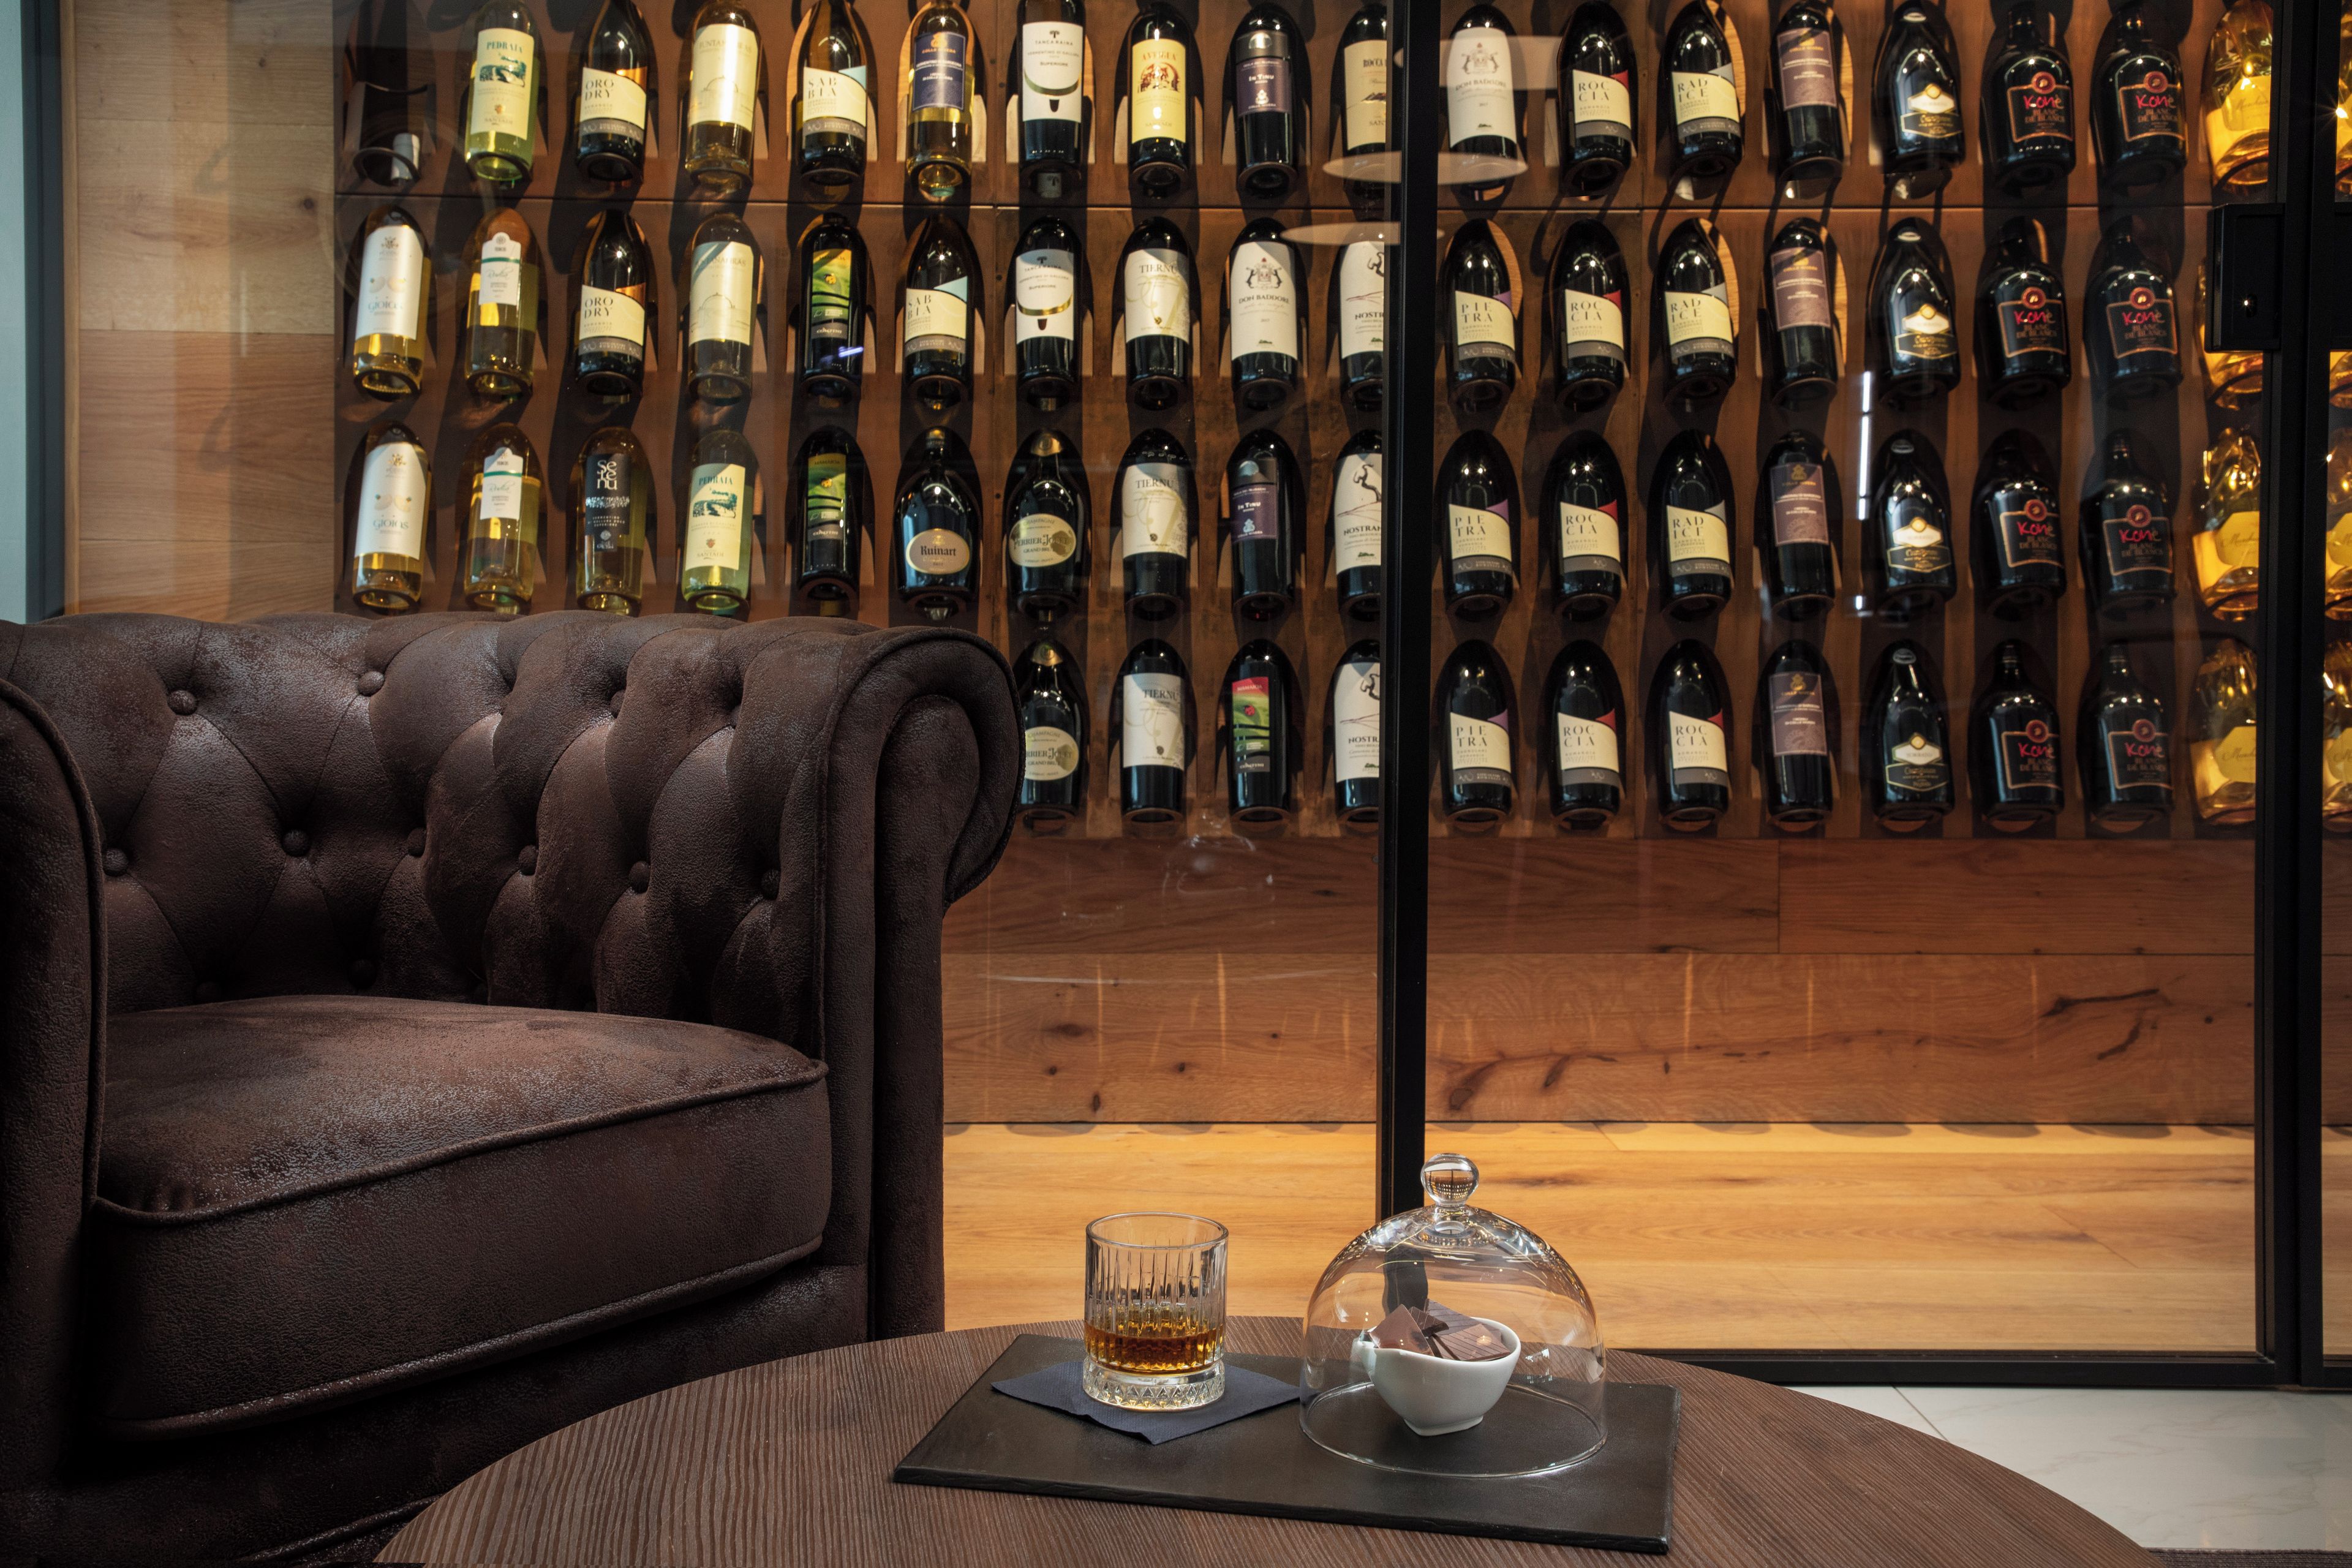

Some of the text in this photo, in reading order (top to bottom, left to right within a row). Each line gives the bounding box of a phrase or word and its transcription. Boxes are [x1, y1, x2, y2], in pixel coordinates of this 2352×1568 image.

[585, 79, 614, 90] ORO
[809, 76, 837, 88] SAB
[1578, 81, 1610, 92] ROC
[1678, 78, 1708, 92] RAD
[584, 89, 613, 101] DRY
[1578, 91, 1610, 102] CIA
[1678, 91, 1709, 103] ICE
[584, 296, 614, 309] ORO
[907, 294, 932, 308] SAB
[1238, 295, 1255, 305] DON
[1570, 300, 1602, 311] ROC
[1670, 298, 1702, 311] RAD
[584, 306, 612, 318] DRY
[1461, 301, 1492, 314] PIE
[1461, 313, 1493, 324] TRA
[1571, 311, 1602, 322] CIA
[1672, 309, 1702, 323] ICE
[698, 475, 733, 486] PEDRAIA
[1136, 479, 1175, 489] TIERNU
[1455, 514, 1485, 527] PIE
[1566, 513, 1597, 525] ROC
[1673, 516, 1704, 529] RAD
[1455, 526, 1486, 537] TRA
[1566, 524, 1597, 536] CIA
[1673, 526, 1704, 539] ICE
[921, 545, 957, 557] Ruinart
[1143, 689, 1178, 701] TIERNU
[1456, 725, 1487, 737] PIE
[1563, 725, 1595, 736] ROC
[1675, 725, 1707, 736] ROC
[1456, 736, 1488, 747] TRA
[1564, 736, 1596, 748] CIA
[1676, 736, 1708, 747] CIA
